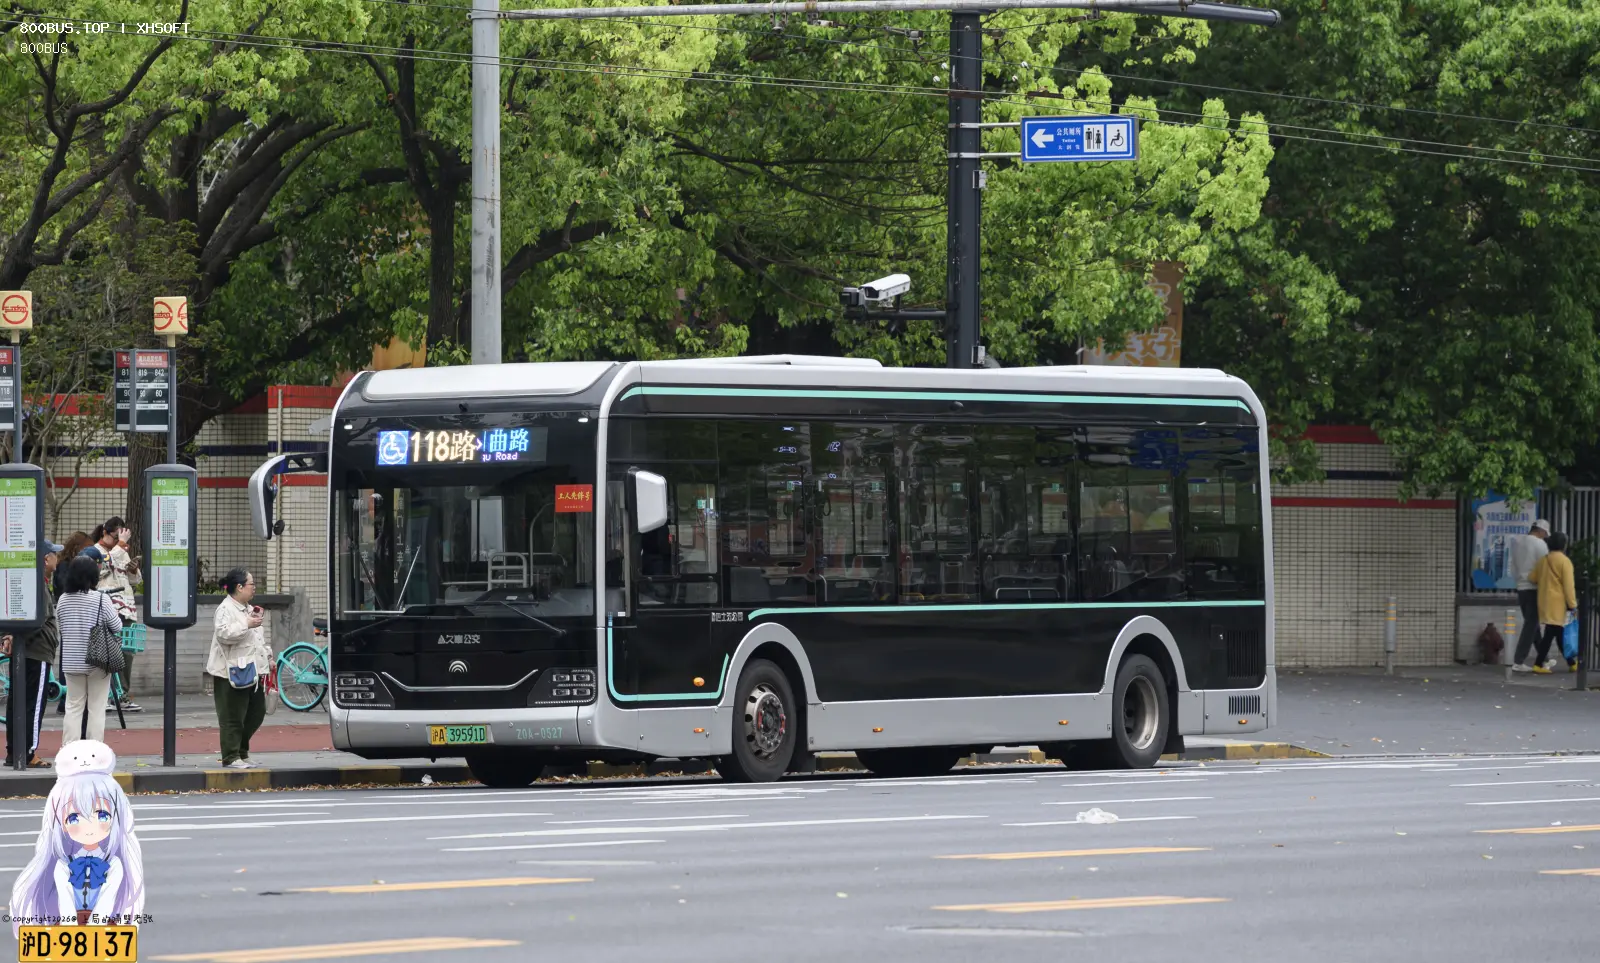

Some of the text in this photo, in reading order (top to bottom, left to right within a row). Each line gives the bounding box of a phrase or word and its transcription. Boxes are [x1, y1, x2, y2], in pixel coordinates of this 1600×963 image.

[121, 368, 131, 377] 81
[138, 368, 165, 377] 819 842
[155, 389, 163, 397] 60
[411, 428, 529, 462] 118路 曲路
[495, 452, 518, 461] Road
